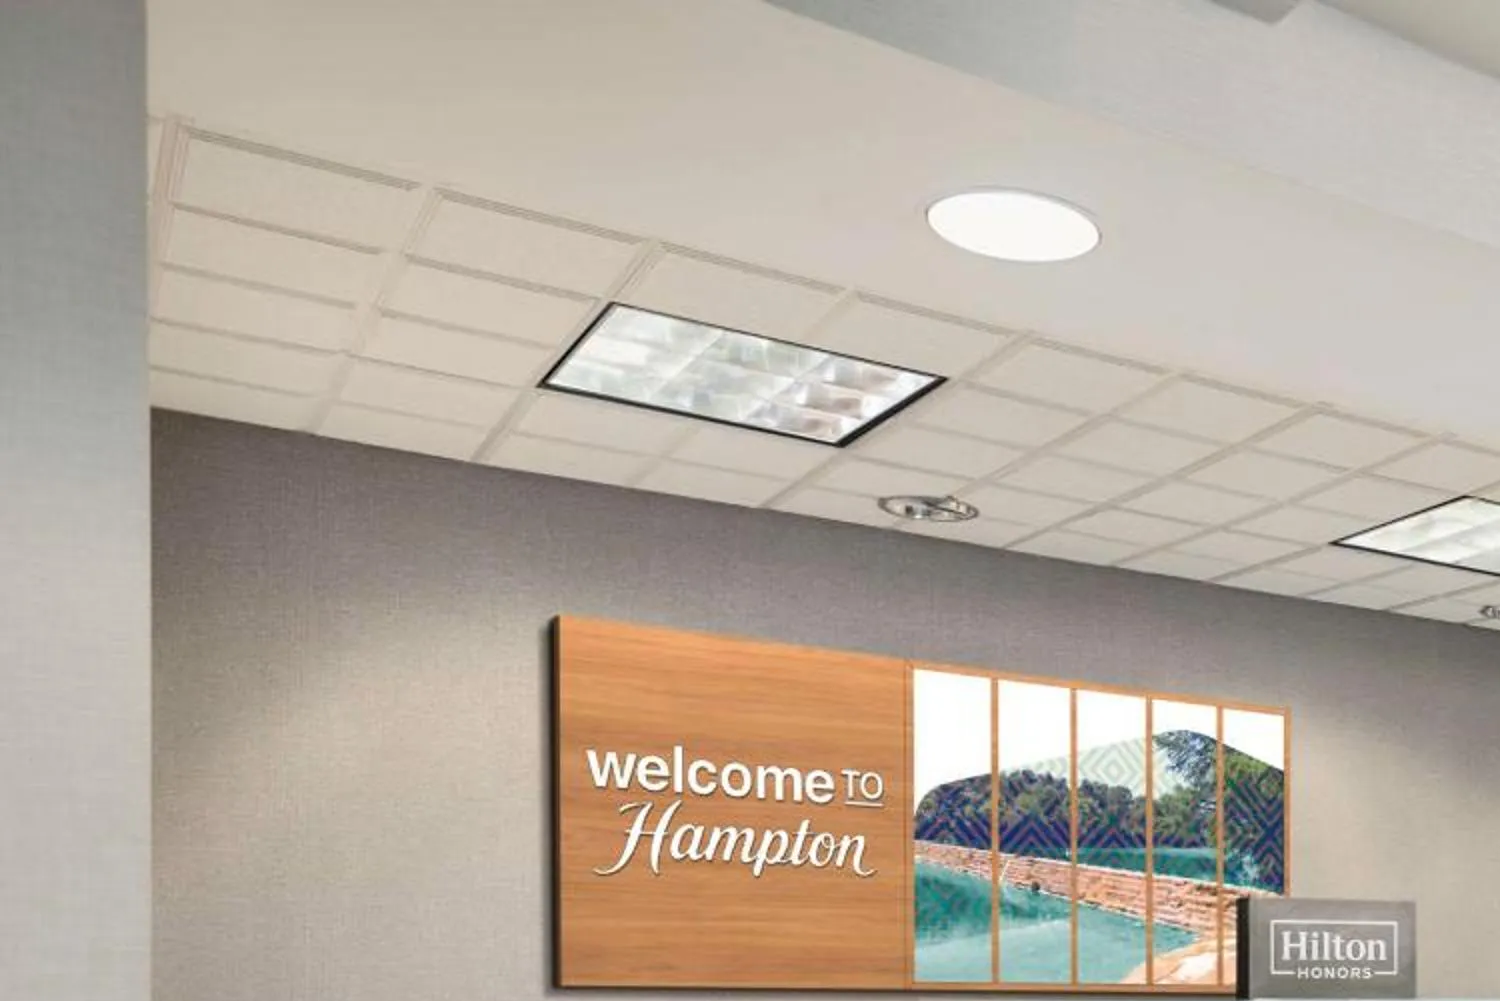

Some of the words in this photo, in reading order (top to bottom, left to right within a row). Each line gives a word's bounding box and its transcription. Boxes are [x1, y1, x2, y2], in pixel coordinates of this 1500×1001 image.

[586, 746, 836, 803] welcome
[842, 769, 885, 802] TO
[593, 799, 878, 878] Hampton
[1281, 930, 1388, 961] Hilton
[1297, 966, 1373, 980] HONORS
